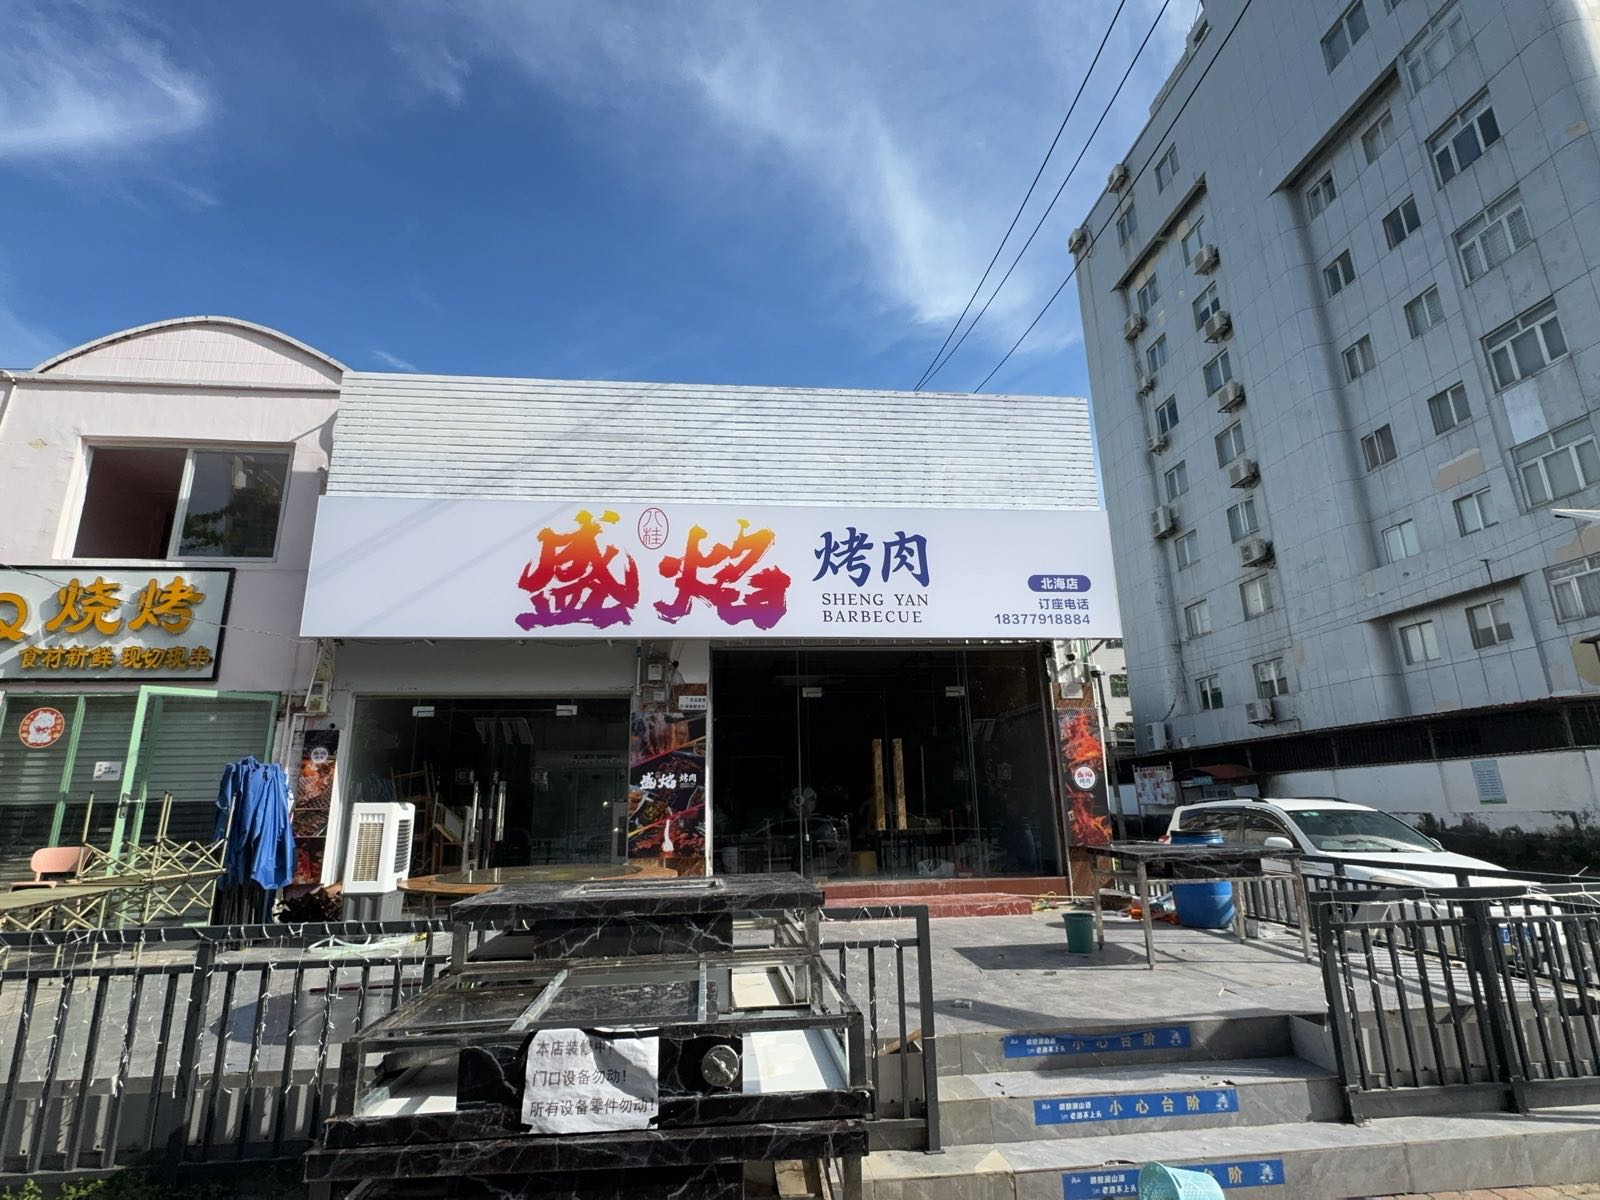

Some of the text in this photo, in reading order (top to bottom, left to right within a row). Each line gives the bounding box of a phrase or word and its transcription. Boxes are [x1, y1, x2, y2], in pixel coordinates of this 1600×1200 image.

[642, 510, 662, 546] 八桂
[812, 527, 930, 587] 烤肉
[1040, 577, 1079, 590] 北海店
[45, 575, 206, 636] 烧烤
[821, 593, 929, 606] SHENG YAN
[1038, 598, 1090, 611] 订座电话
[822, 610, 922, 623] BARBECUE
[994, 613, 1091, 625] 18377918884
[19, 645, 212, 669] 食材新鲜 现切现串
[532, 1067, 627, 1087] 门口设备勿动！
[529, 1097, 655, 1118] 所有设备零件勿动！
[1109, 1095, 1200, 1116] 小心台阶
